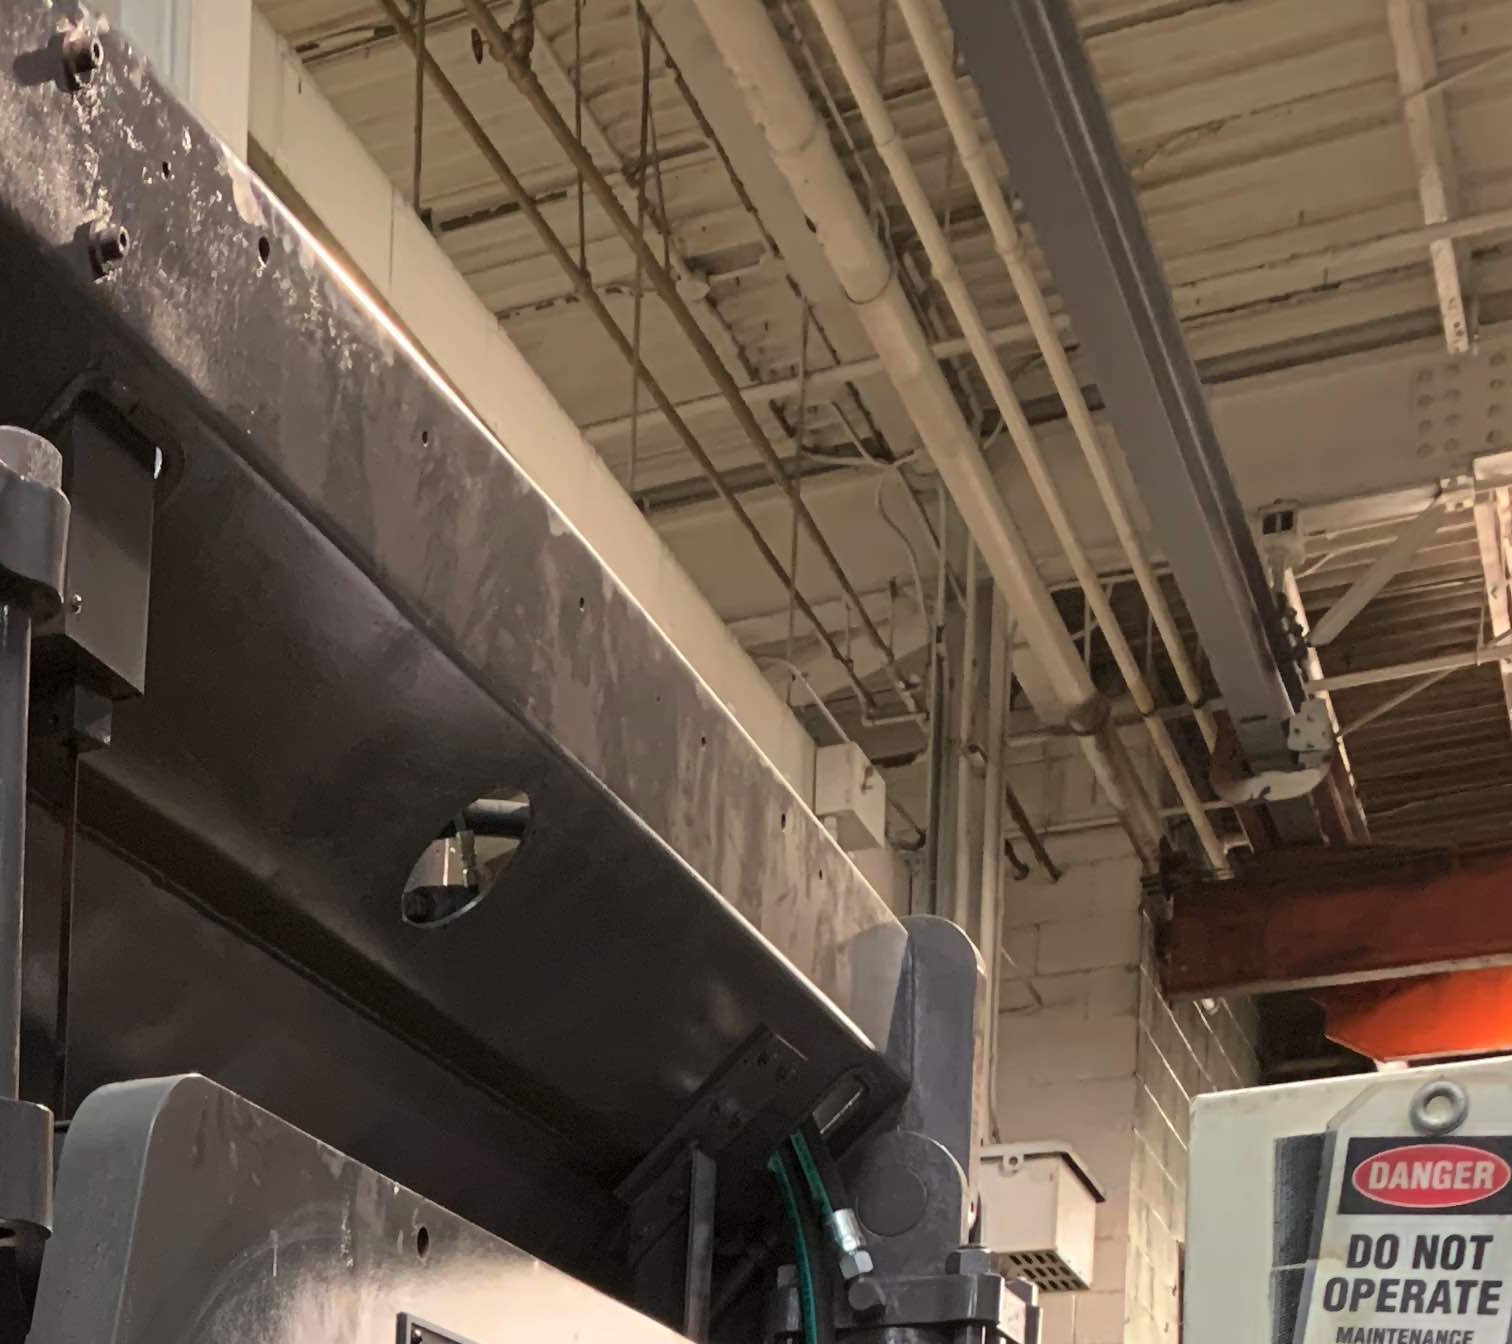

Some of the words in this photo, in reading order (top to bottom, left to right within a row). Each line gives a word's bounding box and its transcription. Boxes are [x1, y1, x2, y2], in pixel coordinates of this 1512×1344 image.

[1368, 1160, 1496, 1190] DANGER
[1346, 1233, 1400, 1270] DO
[1412, 1234, 1494, 1271] NOT
[1323, 1277, 1503, 1316] OPERATE
